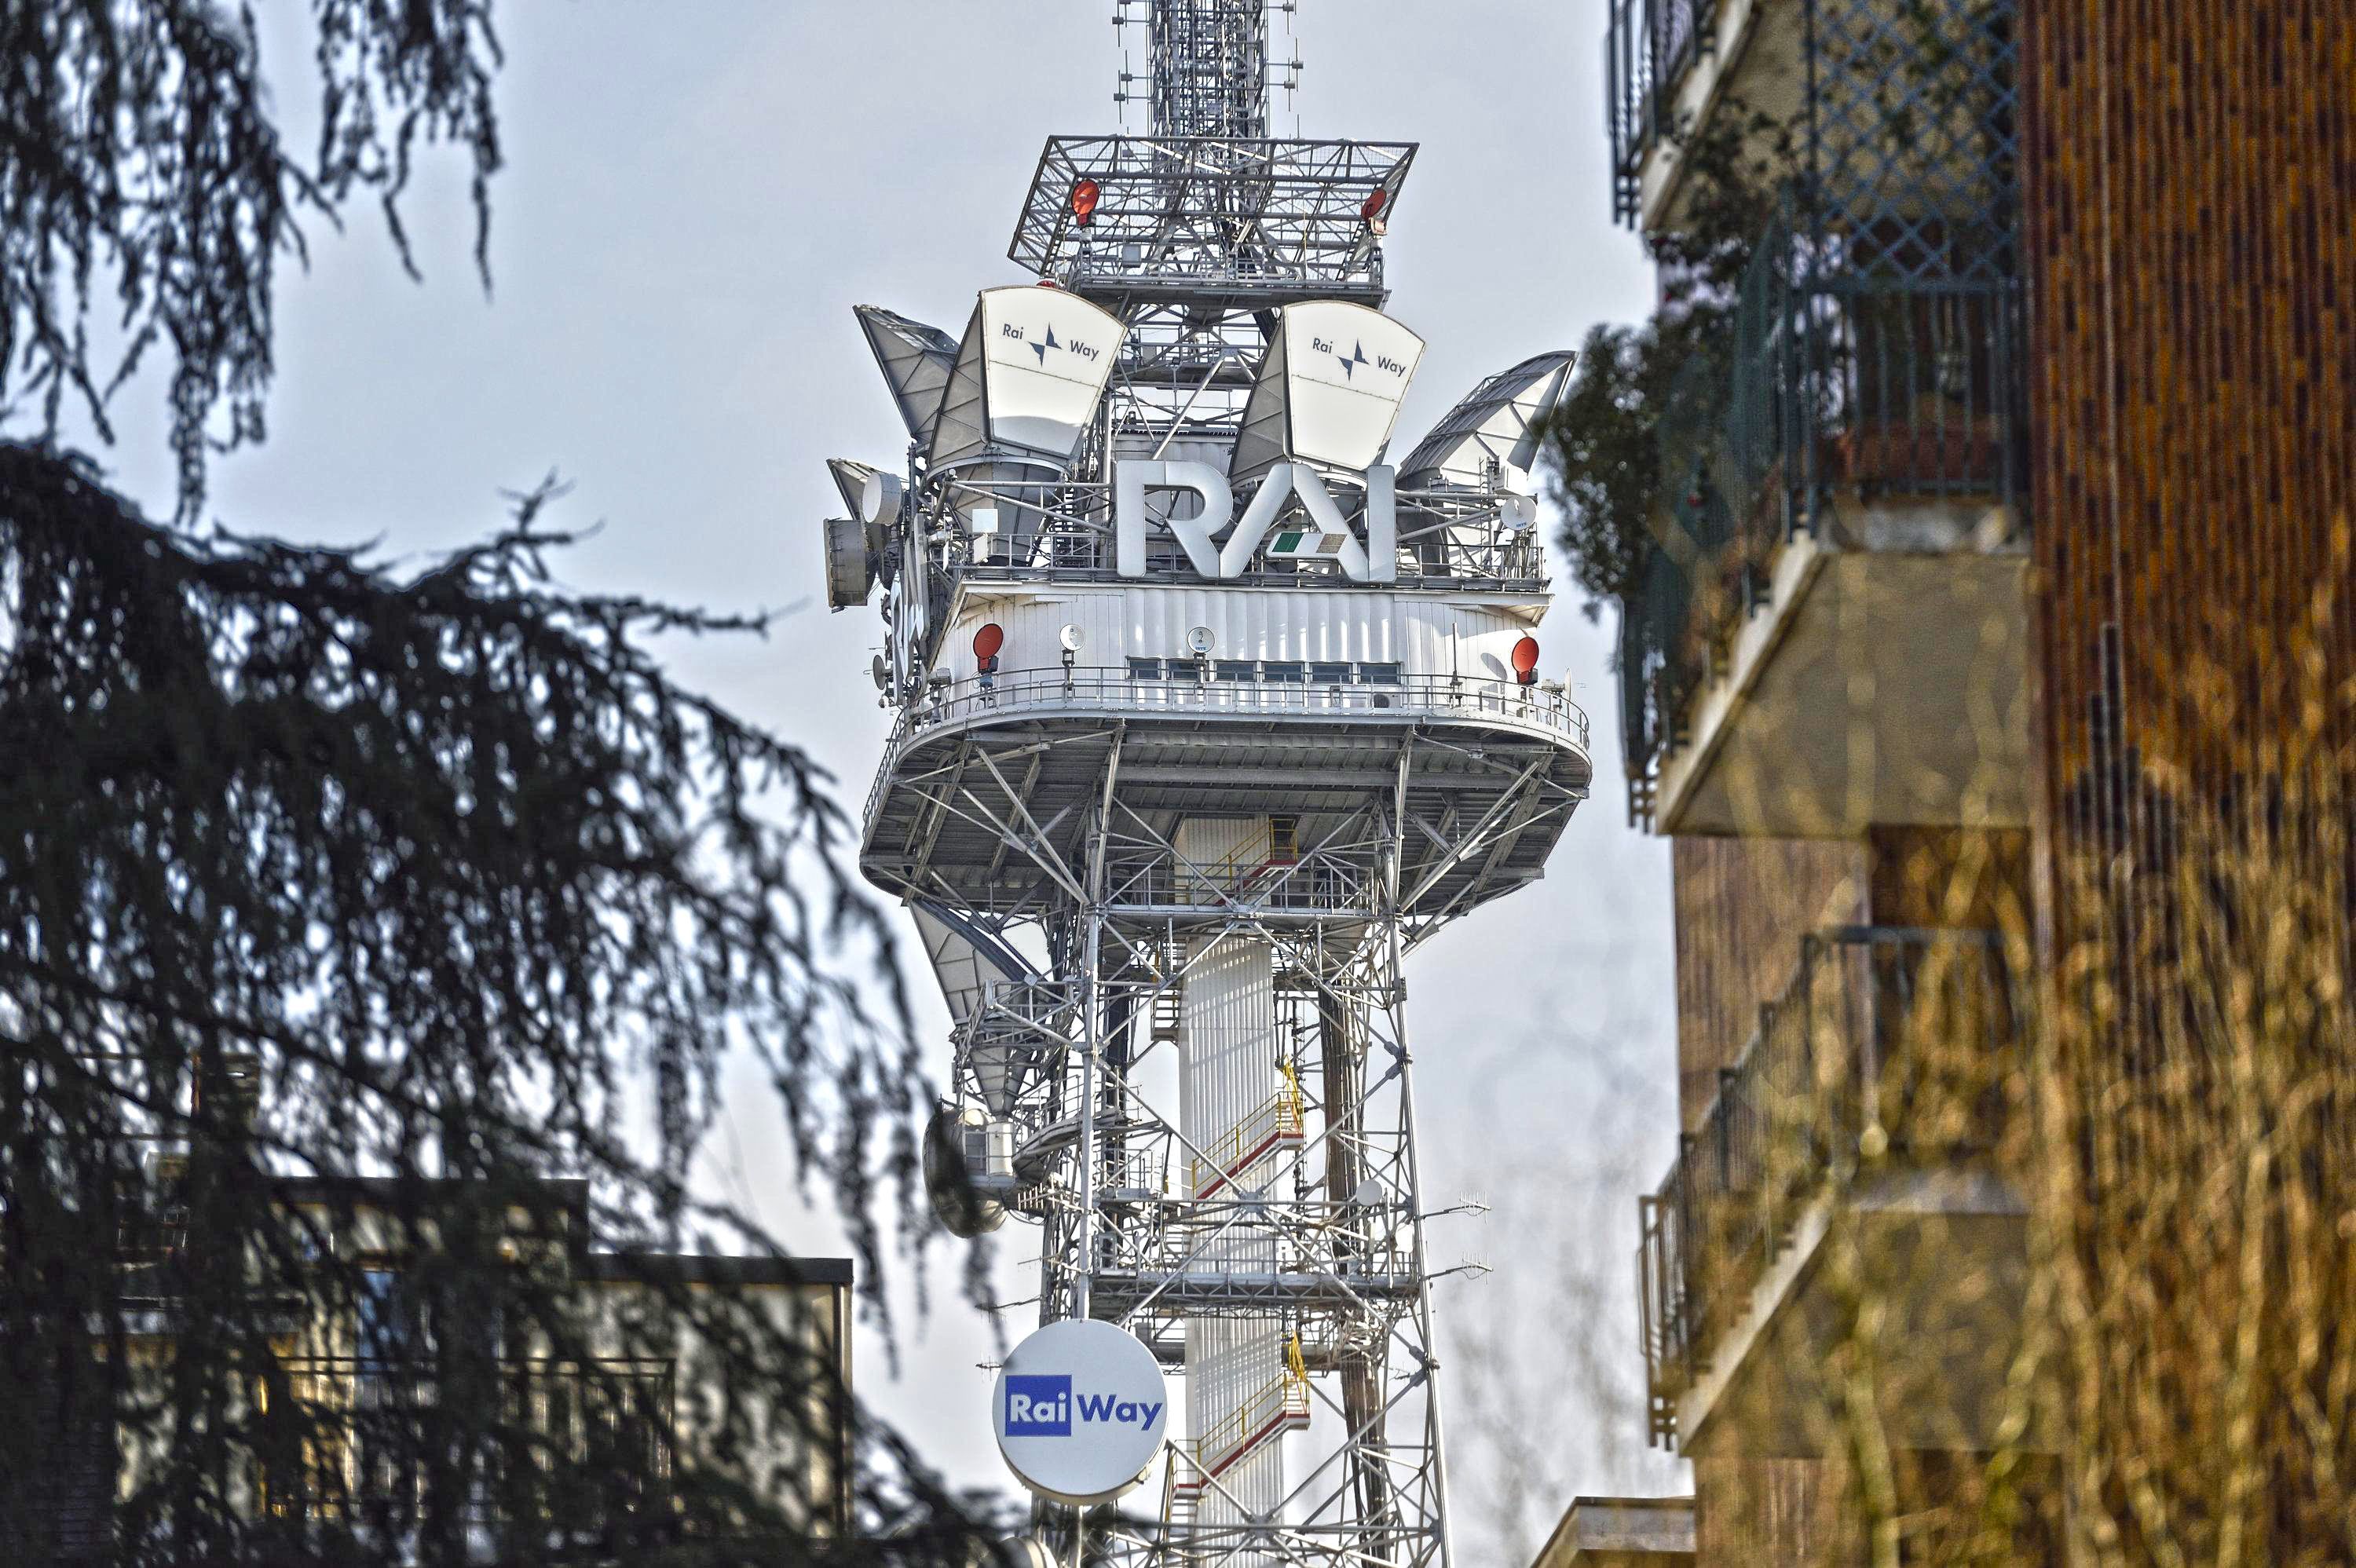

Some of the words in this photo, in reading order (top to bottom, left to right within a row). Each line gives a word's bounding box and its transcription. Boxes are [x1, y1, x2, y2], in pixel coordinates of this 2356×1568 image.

[1002, 323, 1023, 339] Rai
[1070, 339, 1099, 360] Way
[1312, 338, 1333, 353] Rai
[1377, 356, 1406, 377] Way
[1116, 459, 1397, 583] RAI
[1010, 1391, 1066, 1423] Rai
[1076, 1394, 1163, 1431] Way
